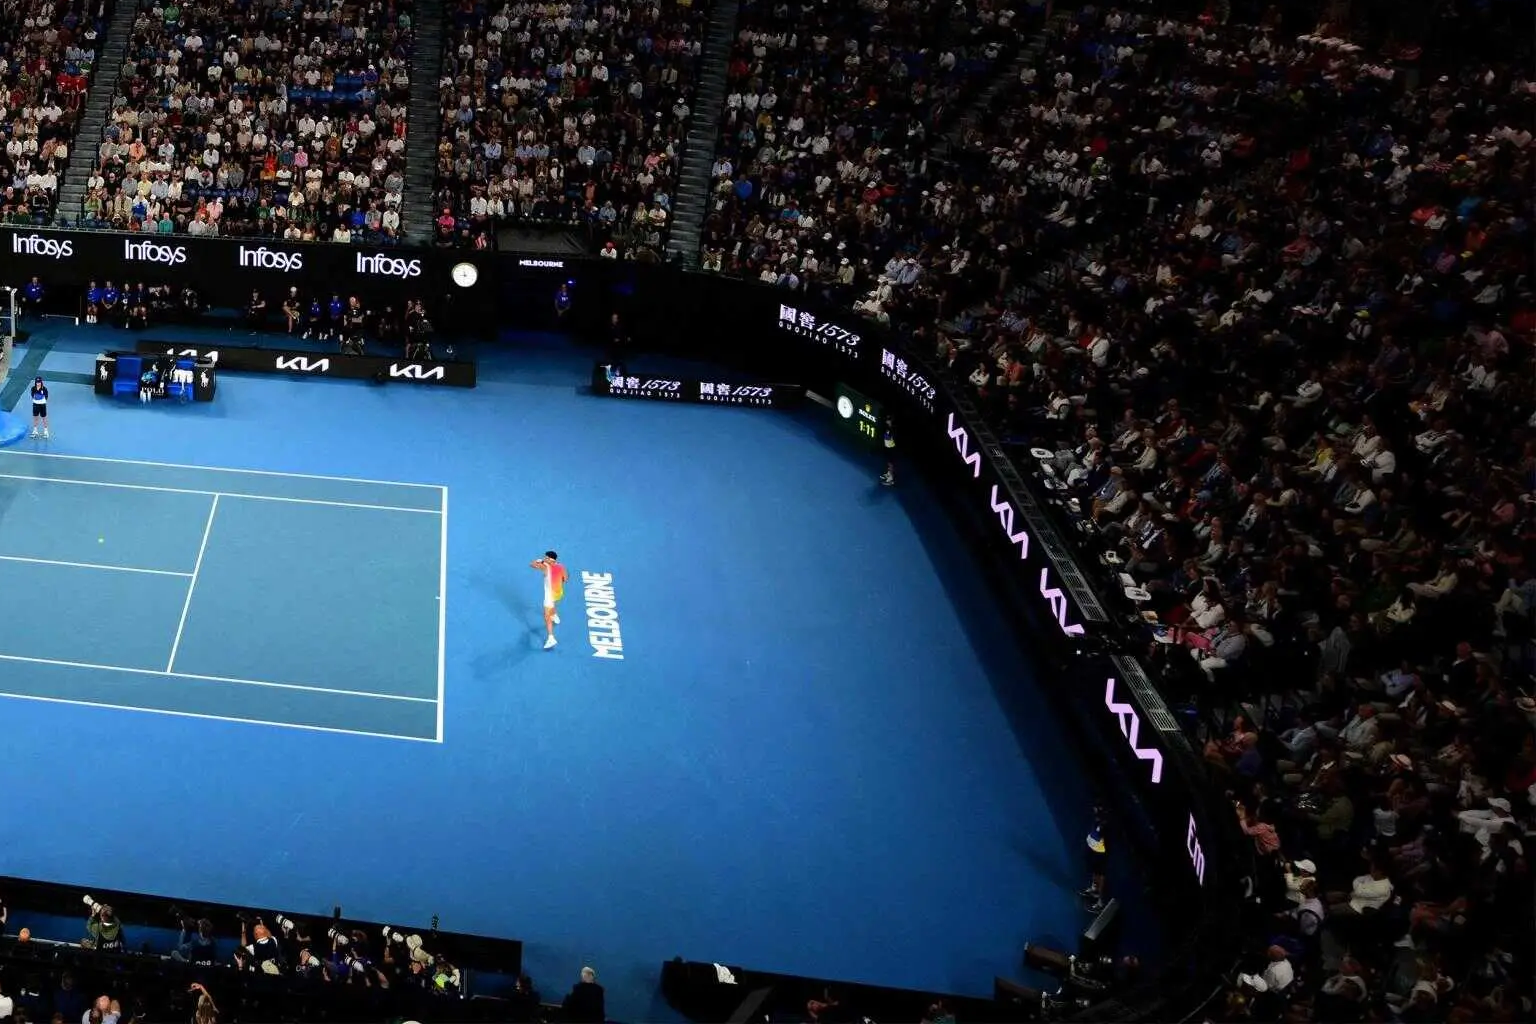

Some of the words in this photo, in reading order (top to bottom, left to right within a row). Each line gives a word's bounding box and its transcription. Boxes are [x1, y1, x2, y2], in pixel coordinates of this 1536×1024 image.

[13, 232, 73, 259] Infosys
[124, 240, 186, 266] Infosys
[239, 246, 302, 272] Infosys
[356, 252, 422, 279] Infosys
[519, 259, 564, 268] MELBOURNE
[778, 321, 828, 345] GUOJIAO
[859, 420, 876, 438] 1:11
[581, 570, 624, 660] MELBOURNE
